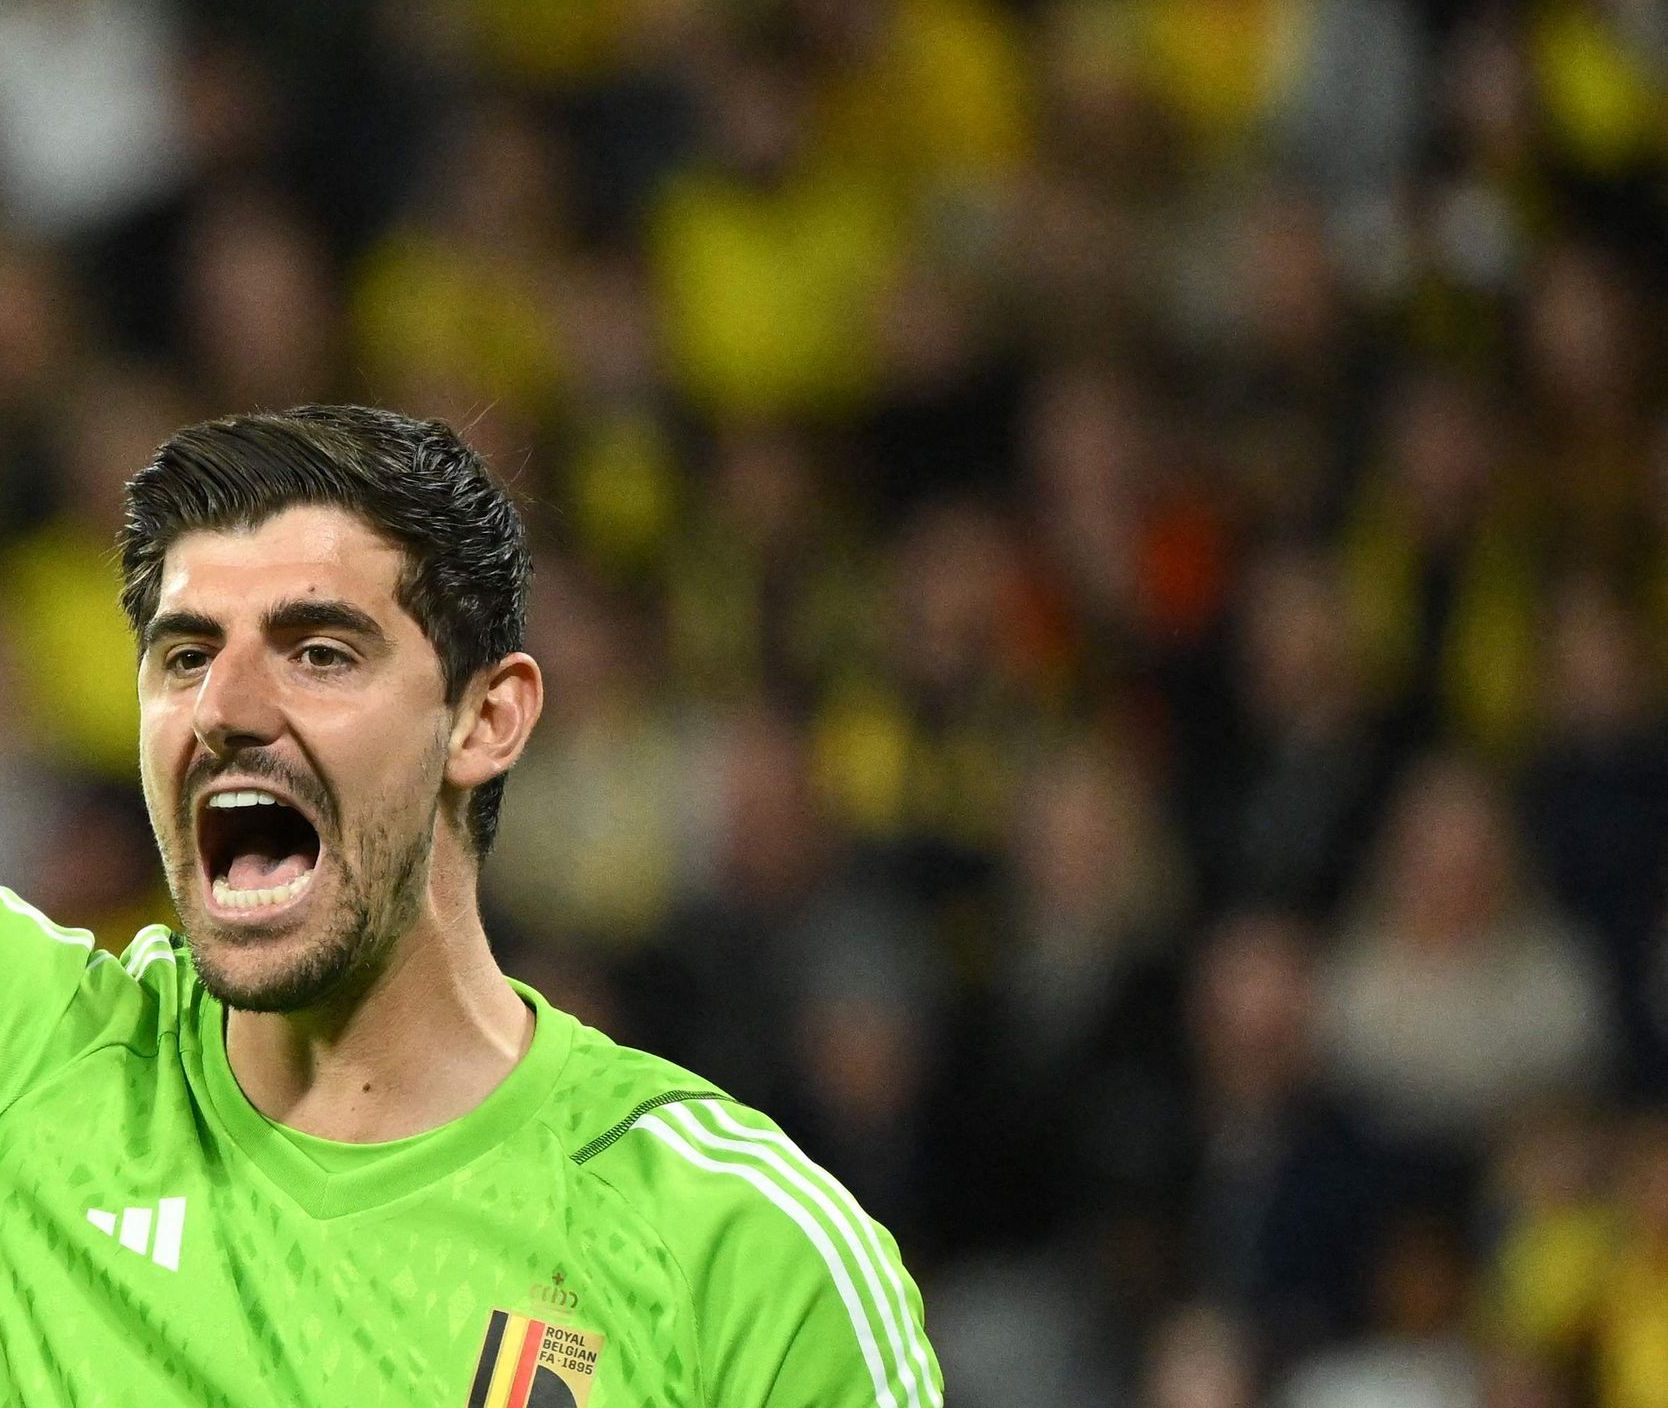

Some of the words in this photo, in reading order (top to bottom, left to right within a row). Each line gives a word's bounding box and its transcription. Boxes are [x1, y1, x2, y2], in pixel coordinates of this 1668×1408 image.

[546, 1326, 585, 1347] ROYAL
[539, 1350, 555, 1364] FA
[561, 1357, 594, 1375] 1895
[543, 1339, 597, 1363] BELGIAN
